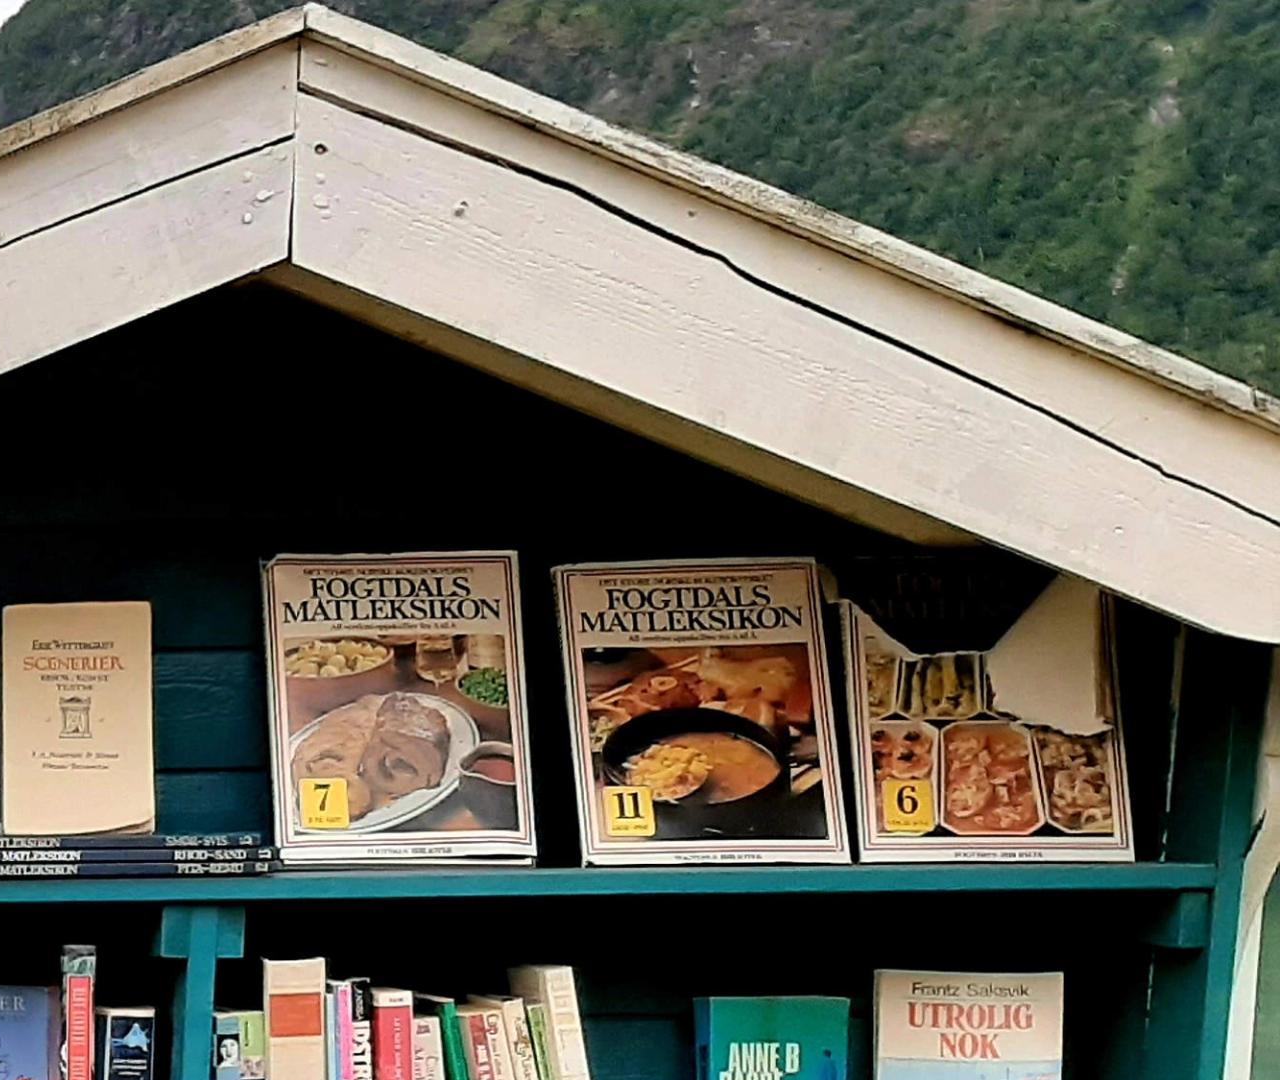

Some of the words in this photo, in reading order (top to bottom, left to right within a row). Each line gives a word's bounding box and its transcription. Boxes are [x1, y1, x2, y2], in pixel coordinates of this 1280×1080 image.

[310, 576, 471, 599] FOGTDALS
[606, 585, 771, 611] FOGTDALS
[283, 598, 501, 624] MATLEKSIKON
[580, 606, 803, 633] MATLEKSIKON
[314, 783, 331, 812] 7
[612, 791, 645, 819] 11
[896, 786, 919, 814] 6
[2, 850, 81, 861] MATLEKSIKON
[0, 864, 79, 875] MATLEKSIKON
[911, 981, 960, 997] Frantz
[967, 982, 1030, 997] Saksvik
[907, 1001, 1035, 1031] UTROLIG
[729, 1042, 781, 1073] ANNE
[785, 1042, 800, 1073] B
[940, 1032, 1000, 1059] NOK
